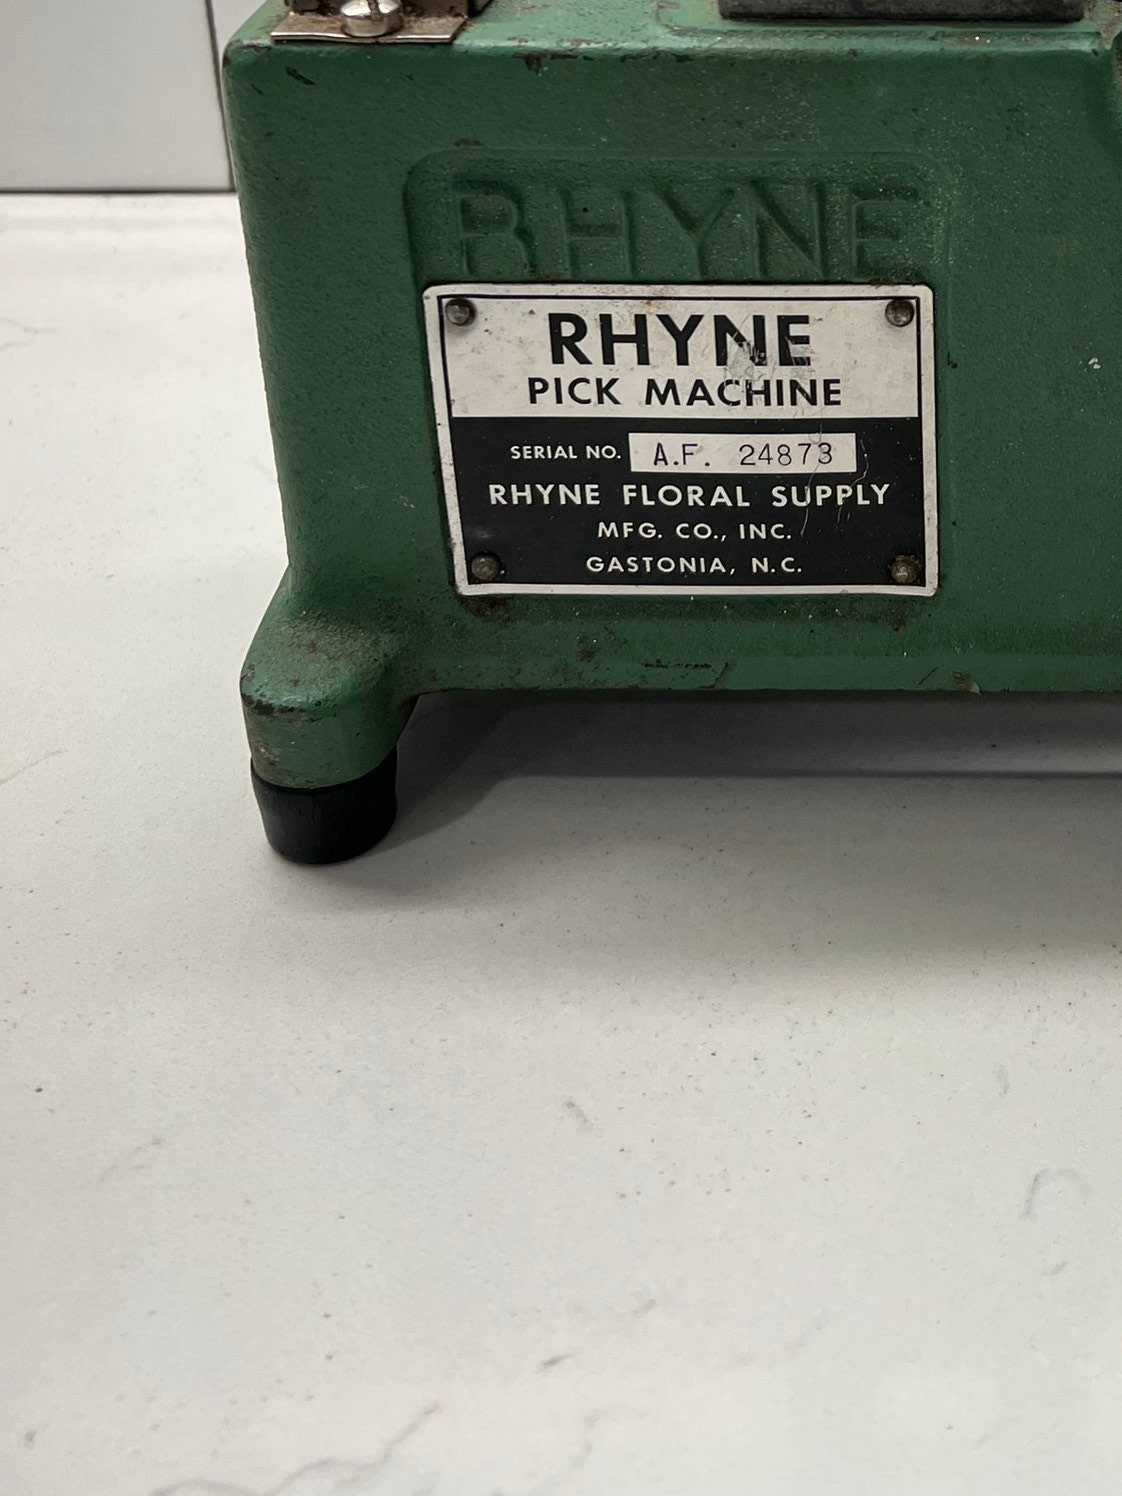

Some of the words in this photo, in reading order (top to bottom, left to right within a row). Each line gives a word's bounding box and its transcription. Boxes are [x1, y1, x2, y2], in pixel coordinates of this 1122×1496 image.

[455, 178, 918, 279] RHYNE
[549, 313, 811, 367] RHYNE
[528, 377, 621, 405] PICK
[645, 378, 842, 407] MACHINE
[510, 445, 578, 460] SERIAL
[585, 445, 622, 459] NO.
[653, 442, 711, 467] A.F.
[739, 441, 833, 467] 24873
[488, 483, 600, 505] RHYNE
[622, 484, 750, 507] FLORAL
[771, 483, 889, 508] SUPPLY
[597, 521, 663, 539] MFG.
[675, 523, 726, 542] CO.,
[739, 523, 792, 540] INC.
[586, 556, 735, 575] GASTONIA,
[751, 557, 802, 573] N.C.
